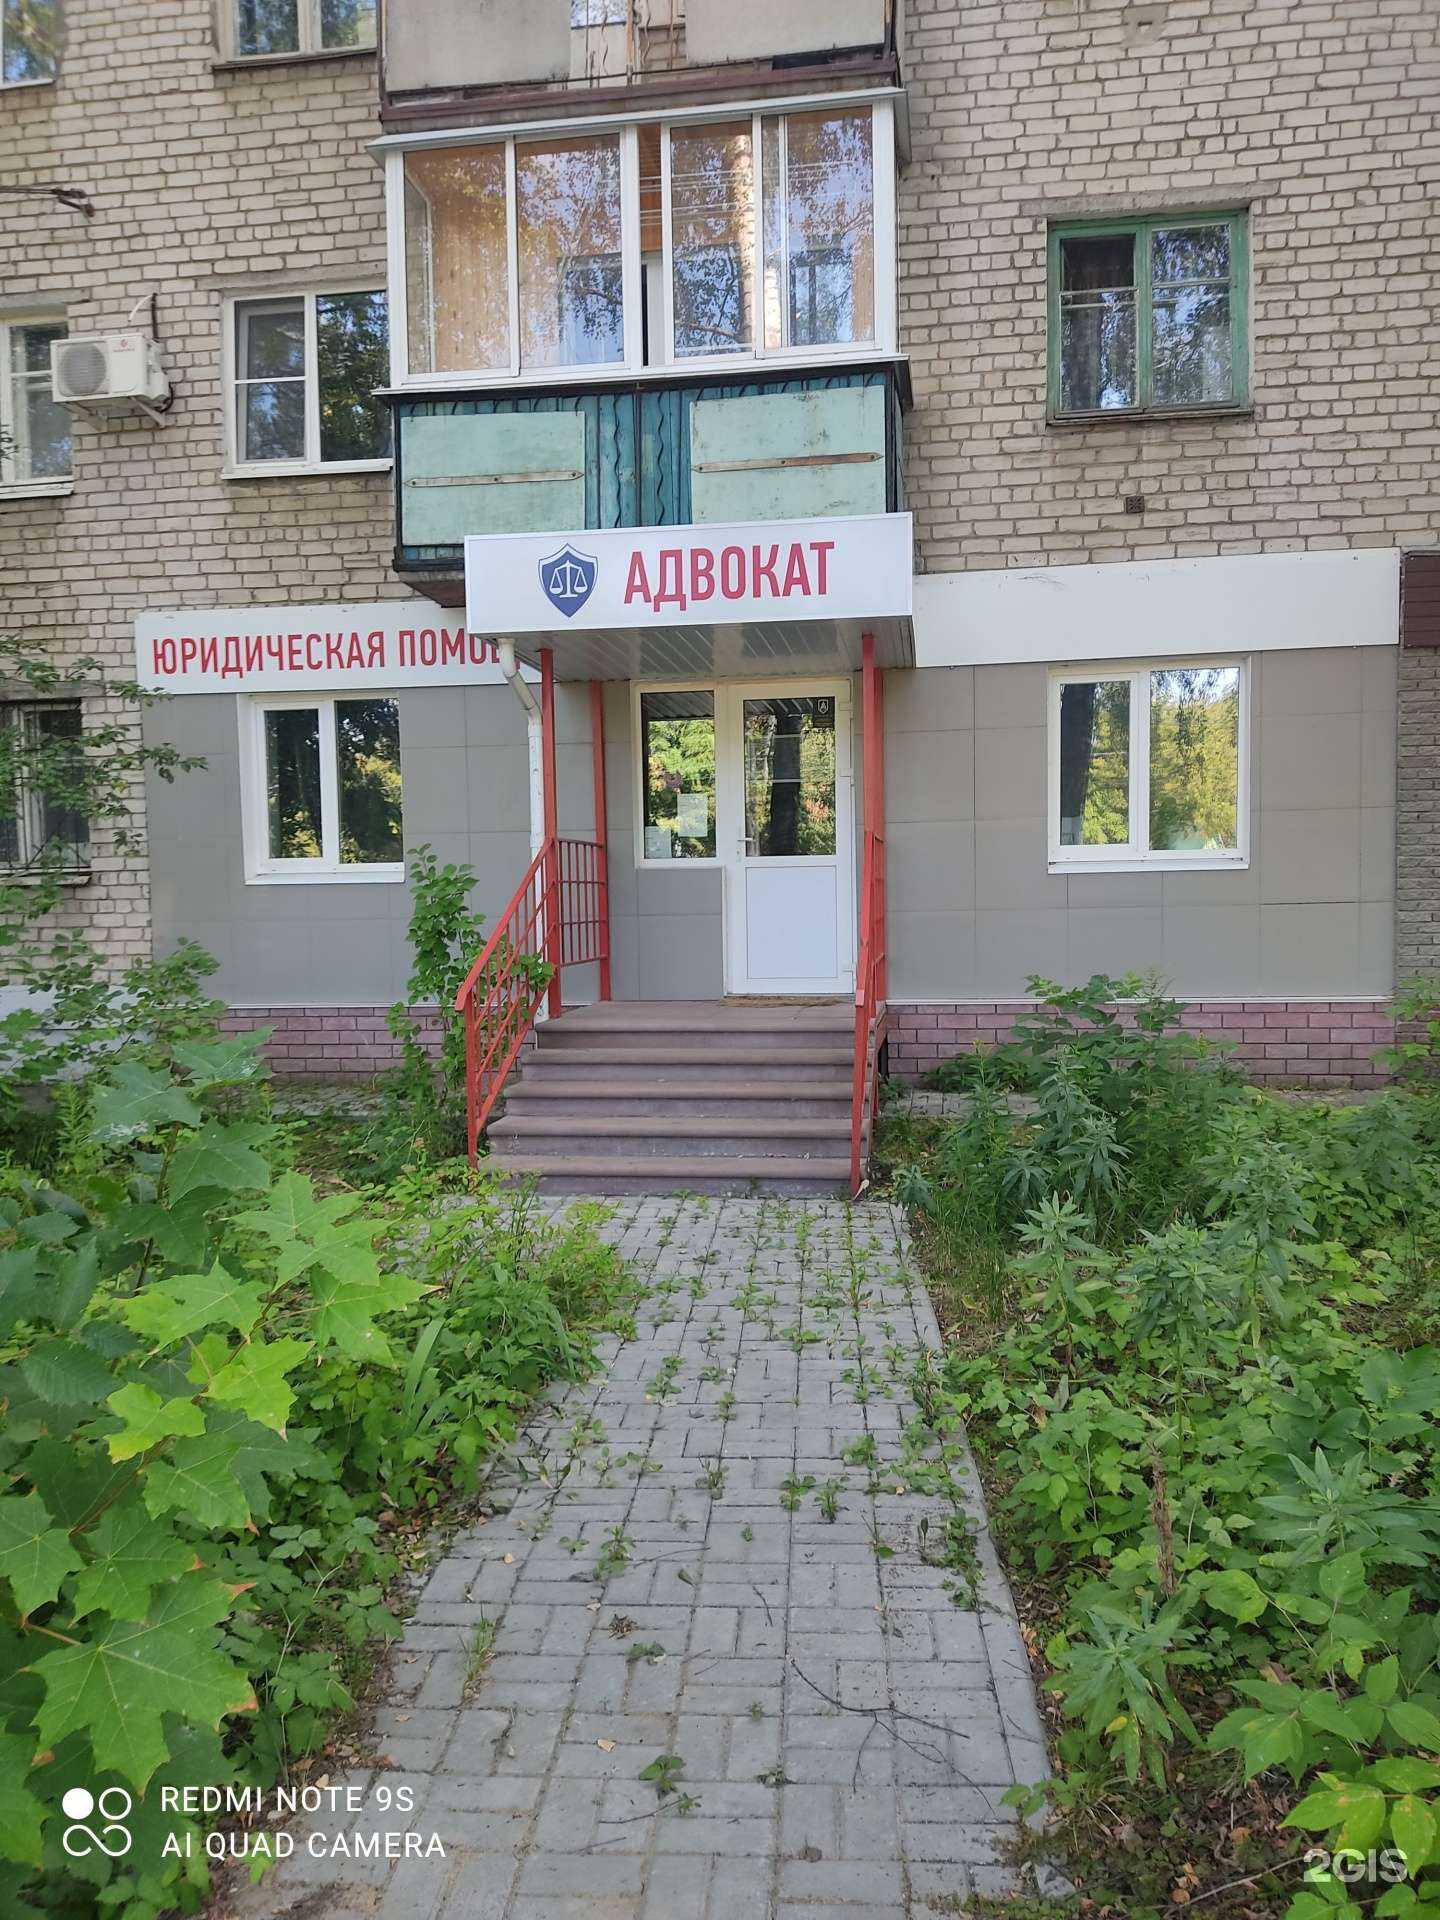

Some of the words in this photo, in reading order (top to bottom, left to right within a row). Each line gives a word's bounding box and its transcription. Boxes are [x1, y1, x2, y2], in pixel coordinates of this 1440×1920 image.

[624, 541, 835, 612] АДВОКАТ
[153, 631, 385, 679] ЮРИДИЧЕСКАЯ
[399, 628, 520, 670] ПОМО
